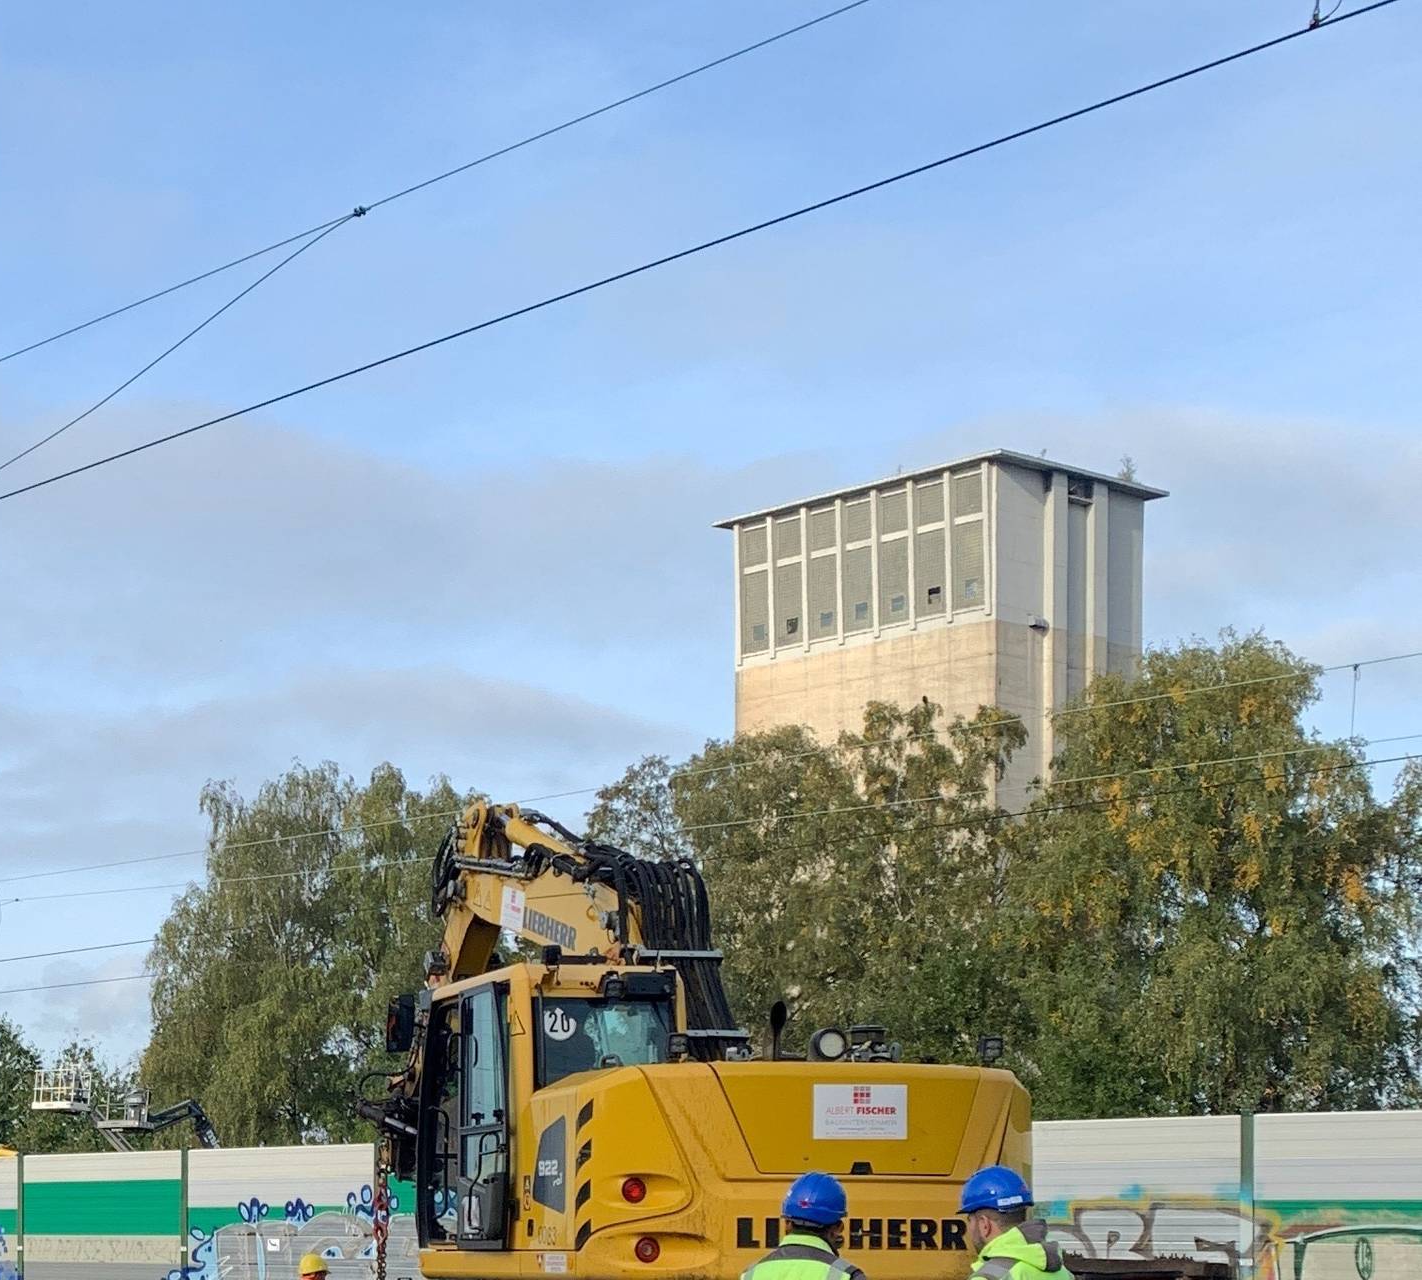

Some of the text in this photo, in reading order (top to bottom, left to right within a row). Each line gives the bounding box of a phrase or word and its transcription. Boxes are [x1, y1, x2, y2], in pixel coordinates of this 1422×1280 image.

[523, 906, 576, 951] LIEBHERR
[549, 1012, 570, 1032] 20
[826, 1106, 897, 1115] ALBERT FISCHER
[538, 1160, 558, 1176] 922
[736, 1217, 968, 1250] LIHERR
